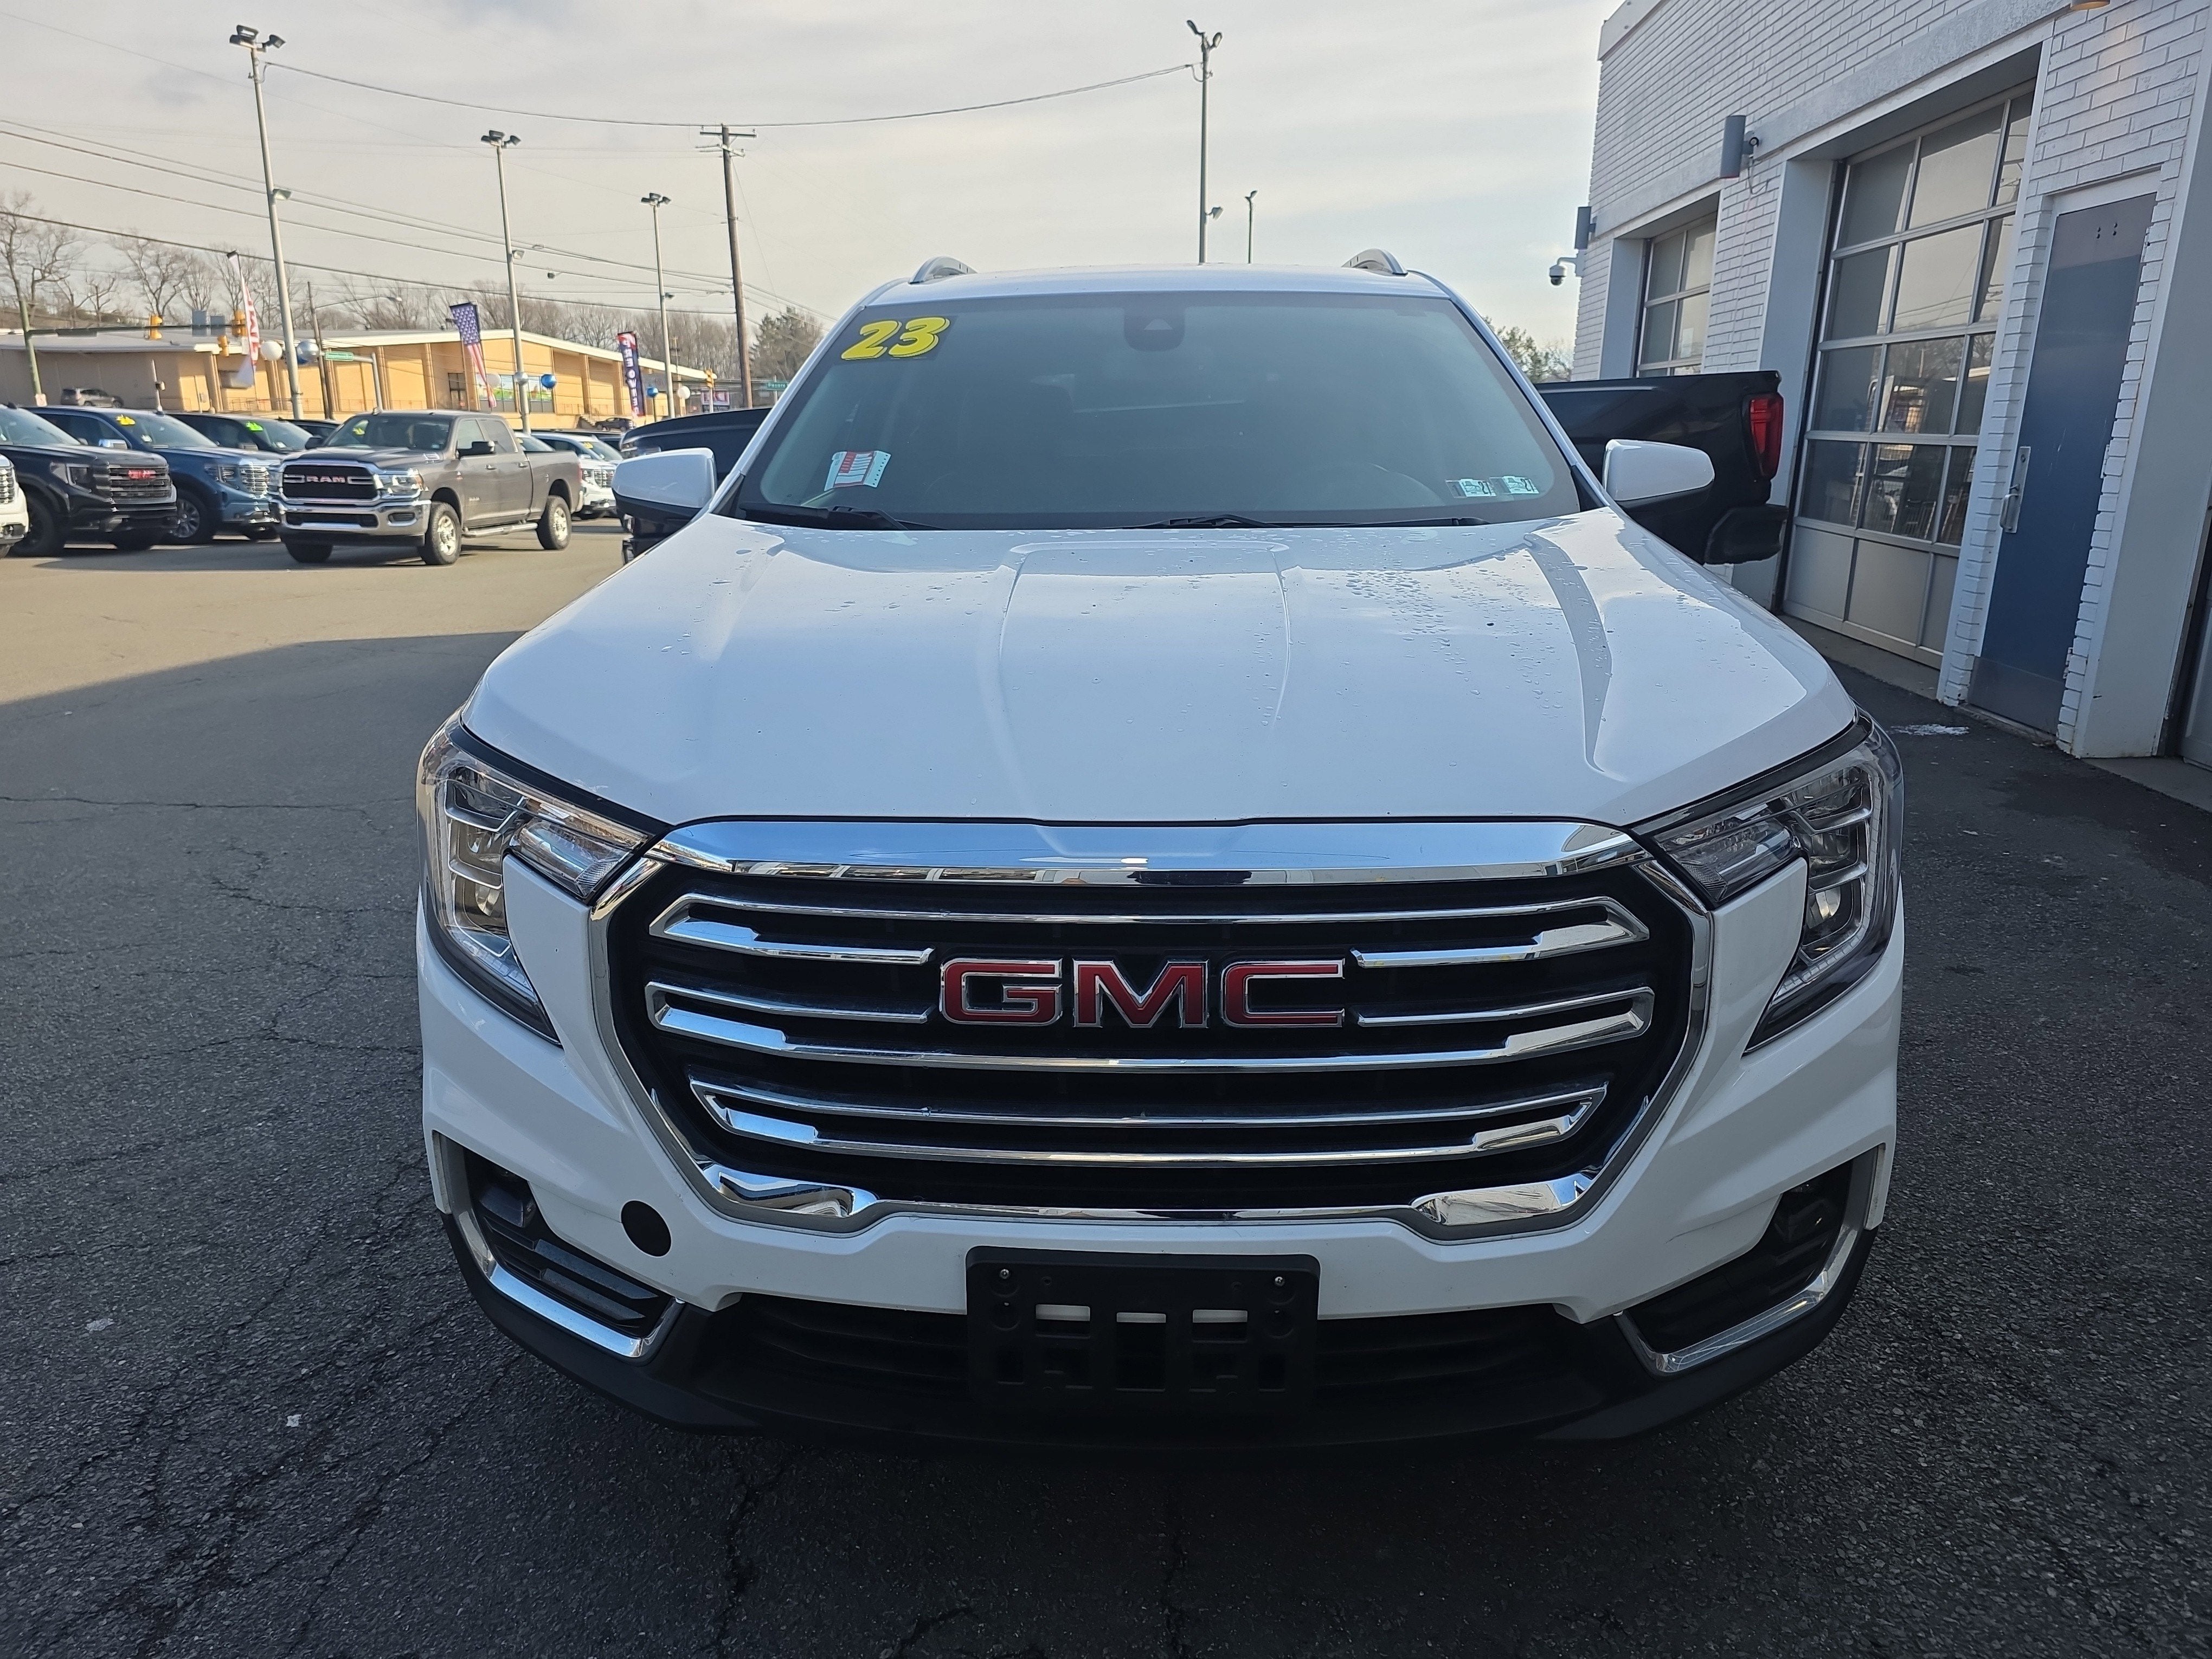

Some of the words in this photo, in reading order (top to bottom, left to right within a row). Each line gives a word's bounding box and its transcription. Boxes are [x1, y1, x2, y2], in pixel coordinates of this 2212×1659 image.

[841, 316, 950, 361] 23
[1478, 481, 1491, 496] 27
[938, 957, 1346, 1029] GMC
